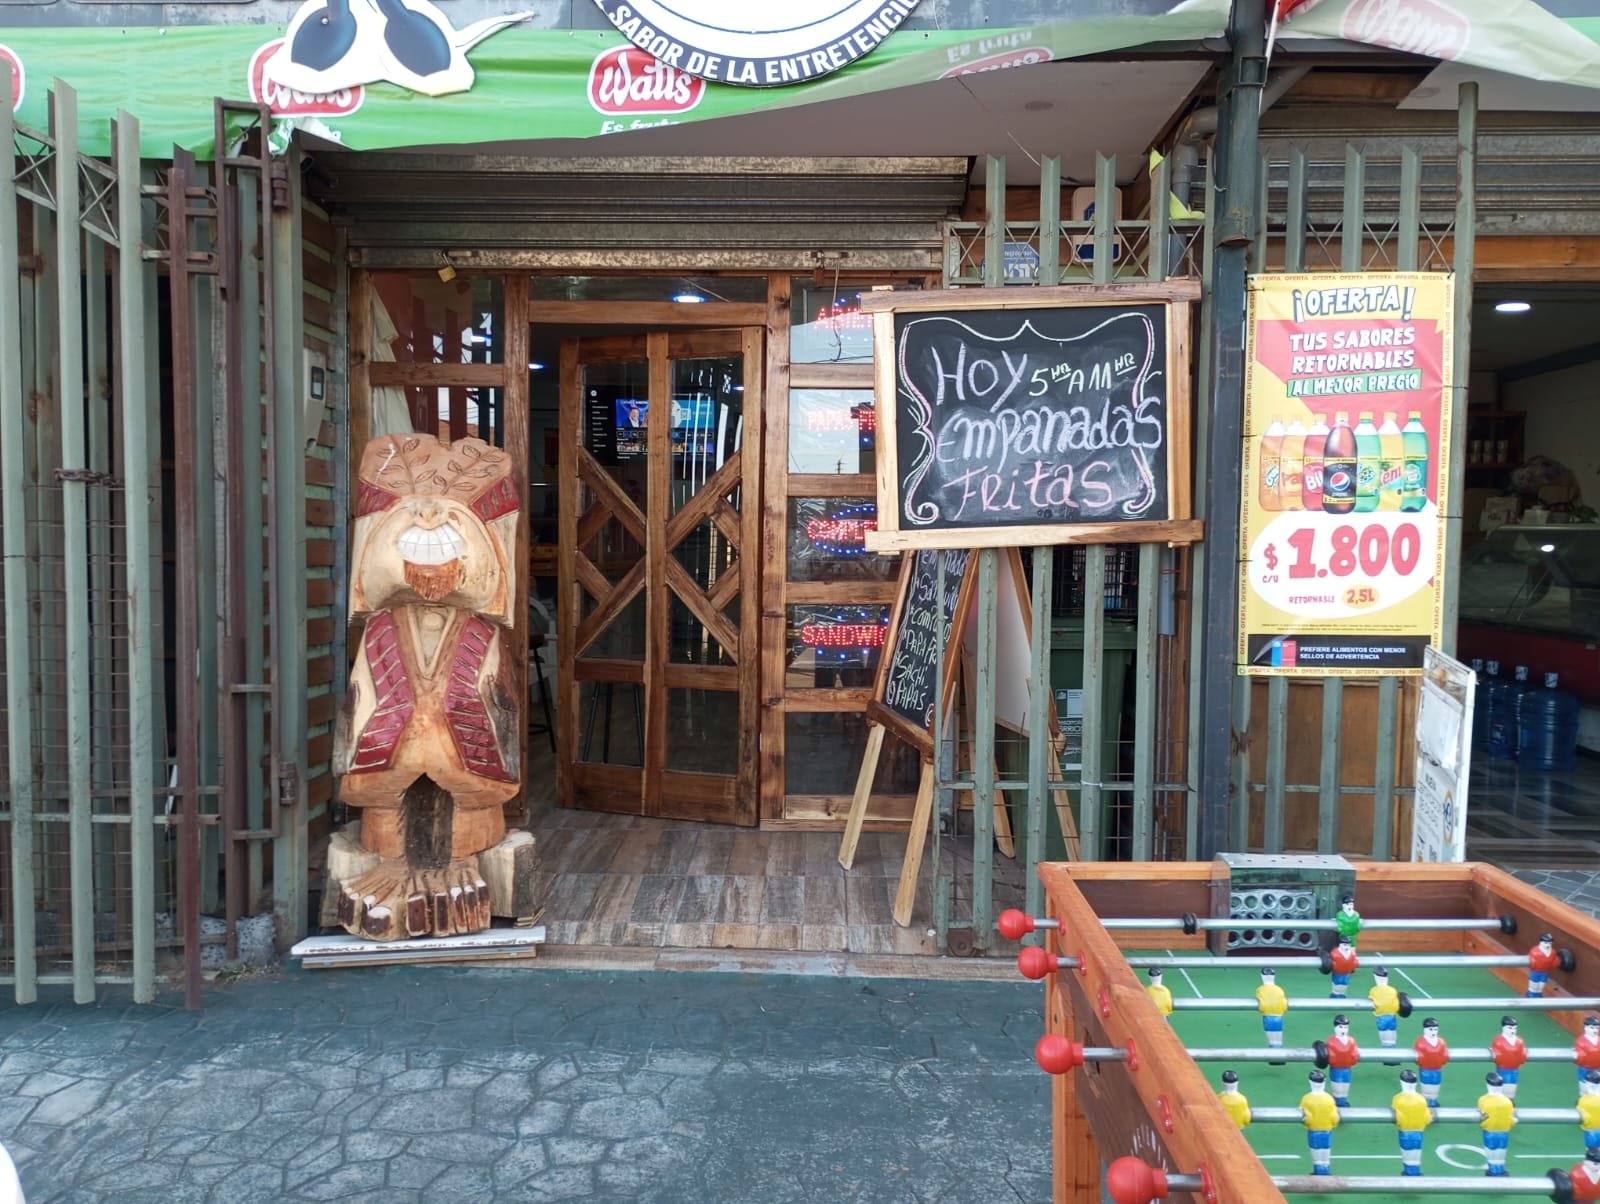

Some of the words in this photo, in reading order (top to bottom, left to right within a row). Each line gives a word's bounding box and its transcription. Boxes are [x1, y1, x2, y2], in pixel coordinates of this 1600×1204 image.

[608, 5, 683, 68] SABOR
[686, 51, 721, 78] DE
[727, 60, 758, 83] LA
[1290, 332, 1327, 352] TUS
[1333, 327, 1415, 350] SABORES
[1292, 350, 1415, 376] RETORNABLES
[932, 341, 1027, 413] HOY
[1292, 379, 1309, 396] AL
[1313, 377, 1362, 395] MEJOR
[1264, 543, 1278, 571] $
[1287, 523, 1421, 579] 1.800
[1289, 595, 1336, 605] RETORNABLE
[1384, 646, 1407, 654] MENOS
